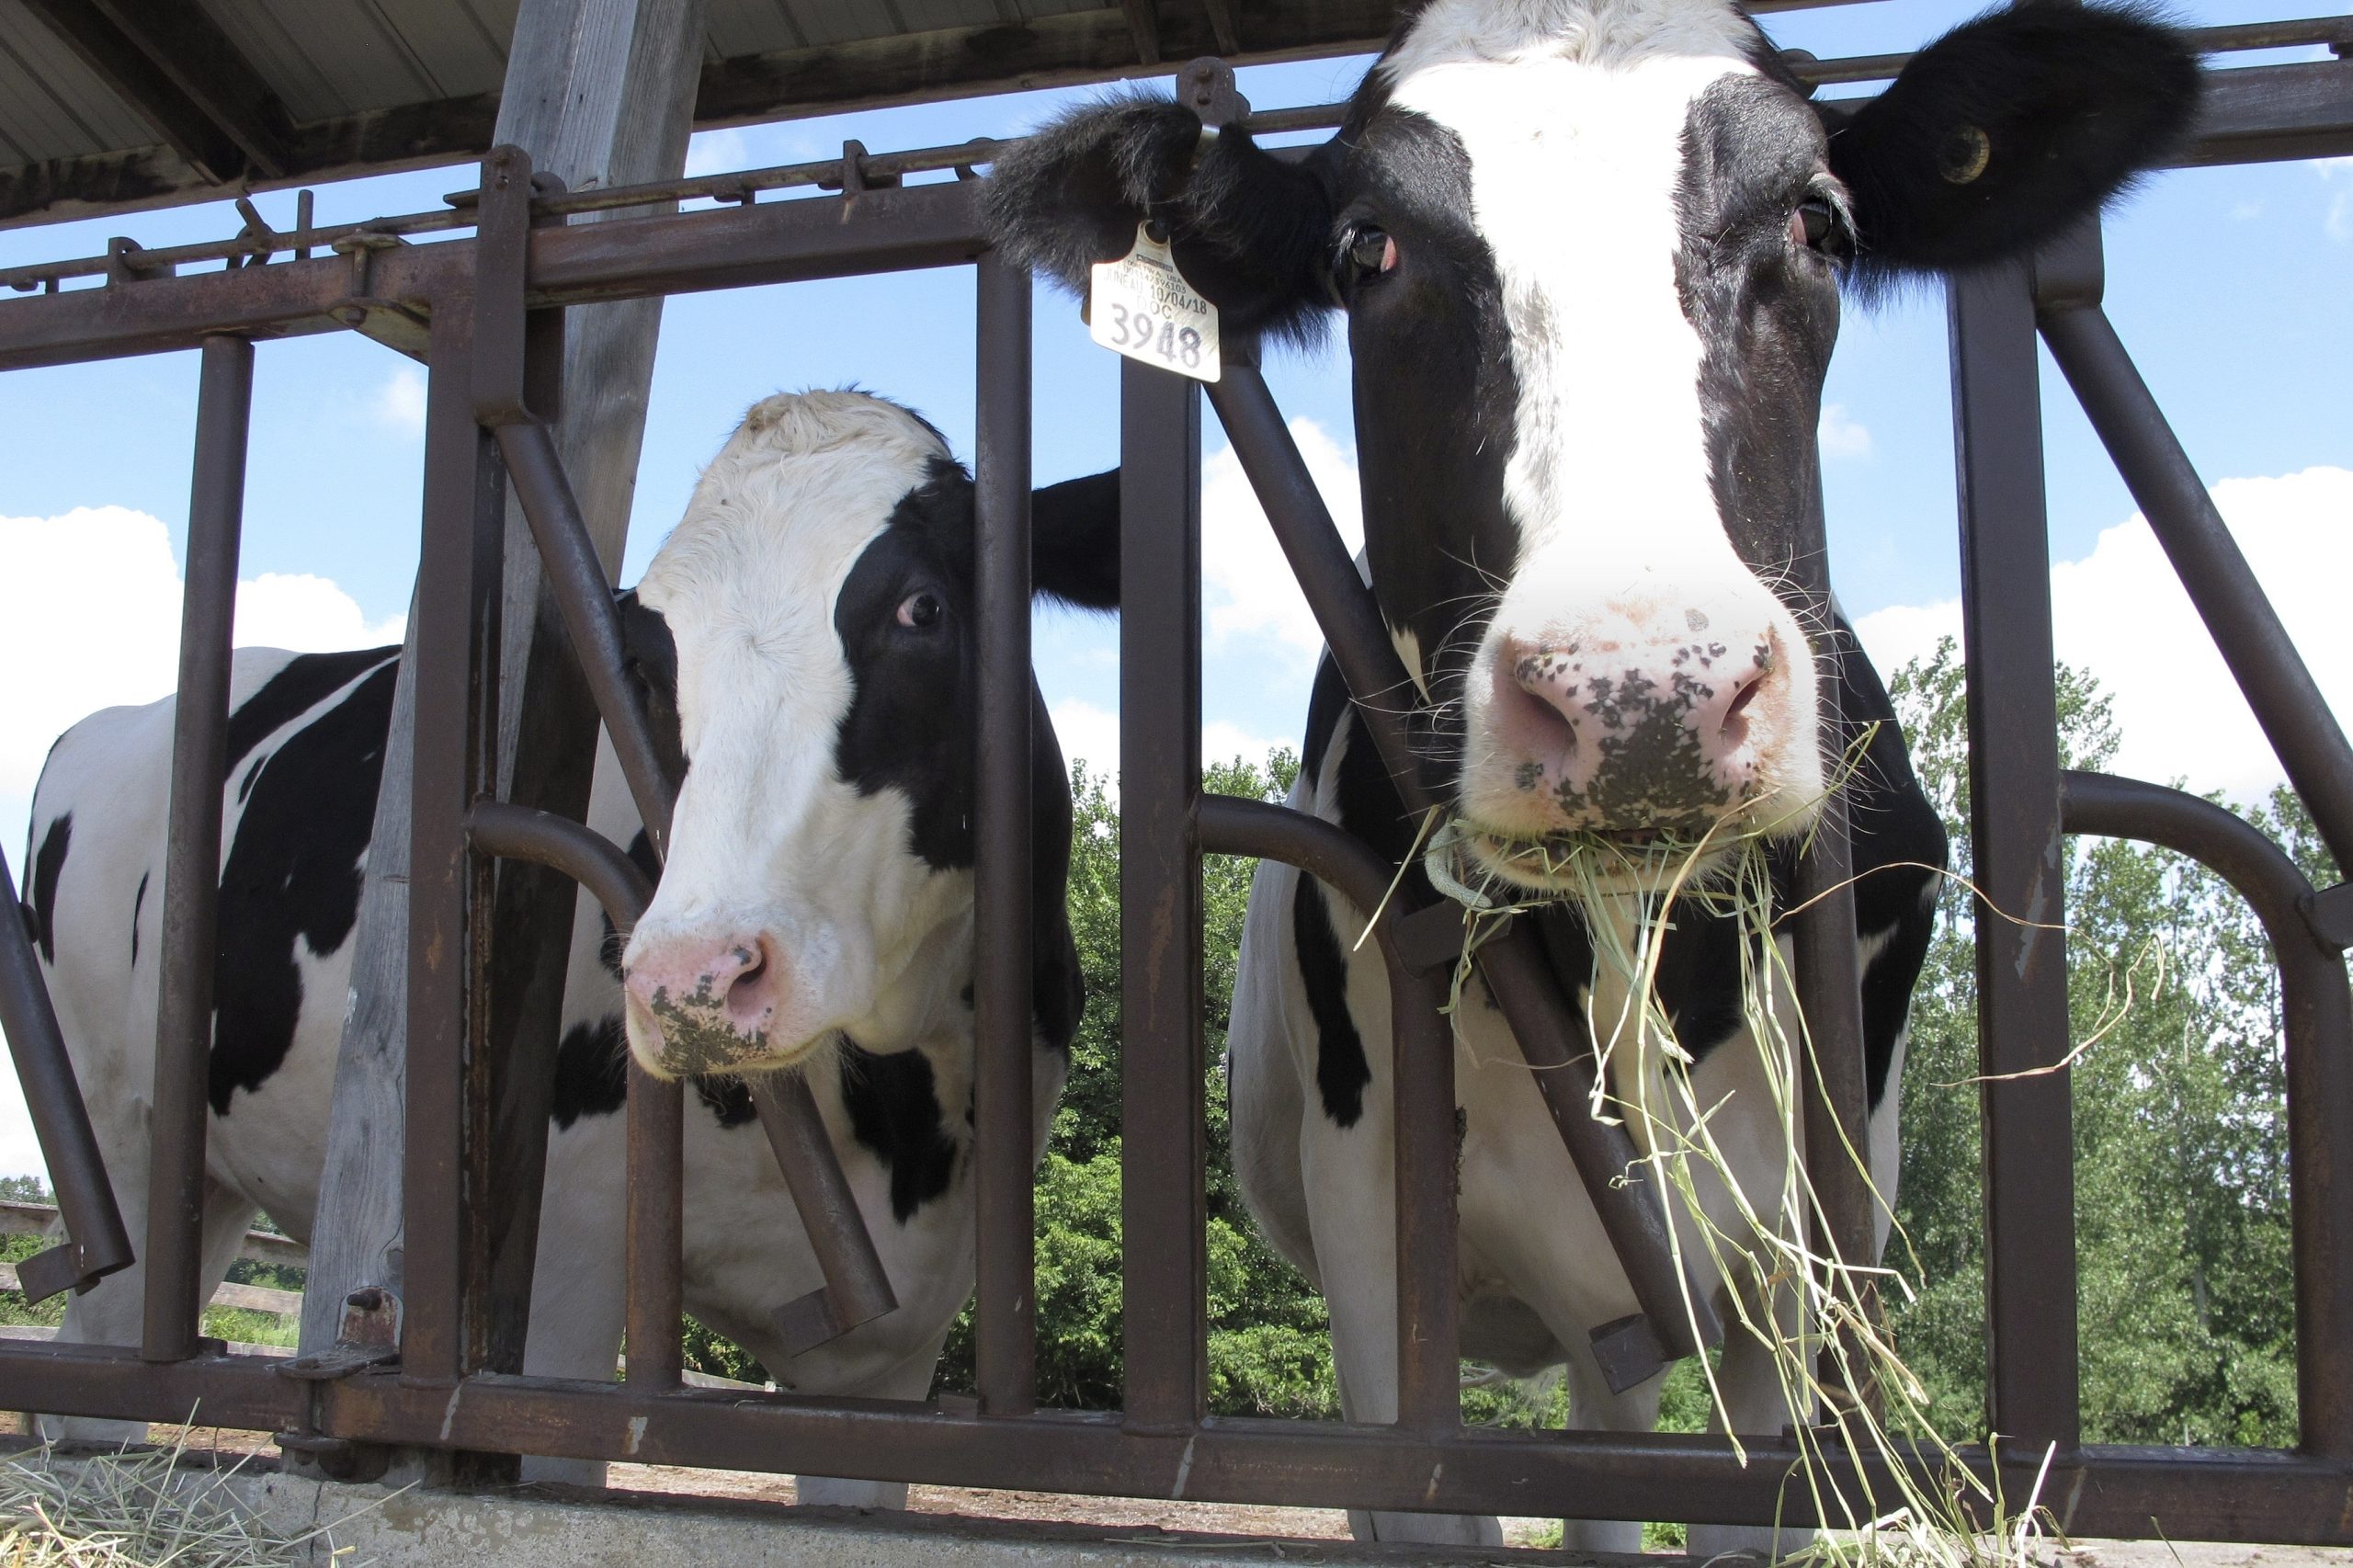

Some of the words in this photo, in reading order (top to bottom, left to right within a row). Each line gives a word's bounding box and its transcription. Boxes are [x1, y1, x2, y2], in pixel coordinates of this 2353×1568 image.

[1137, 295, 1173, 320] DOC
[1150, 284, 1208, 315] 10/04/18
[1110, 302, 1202, 369] 3948
